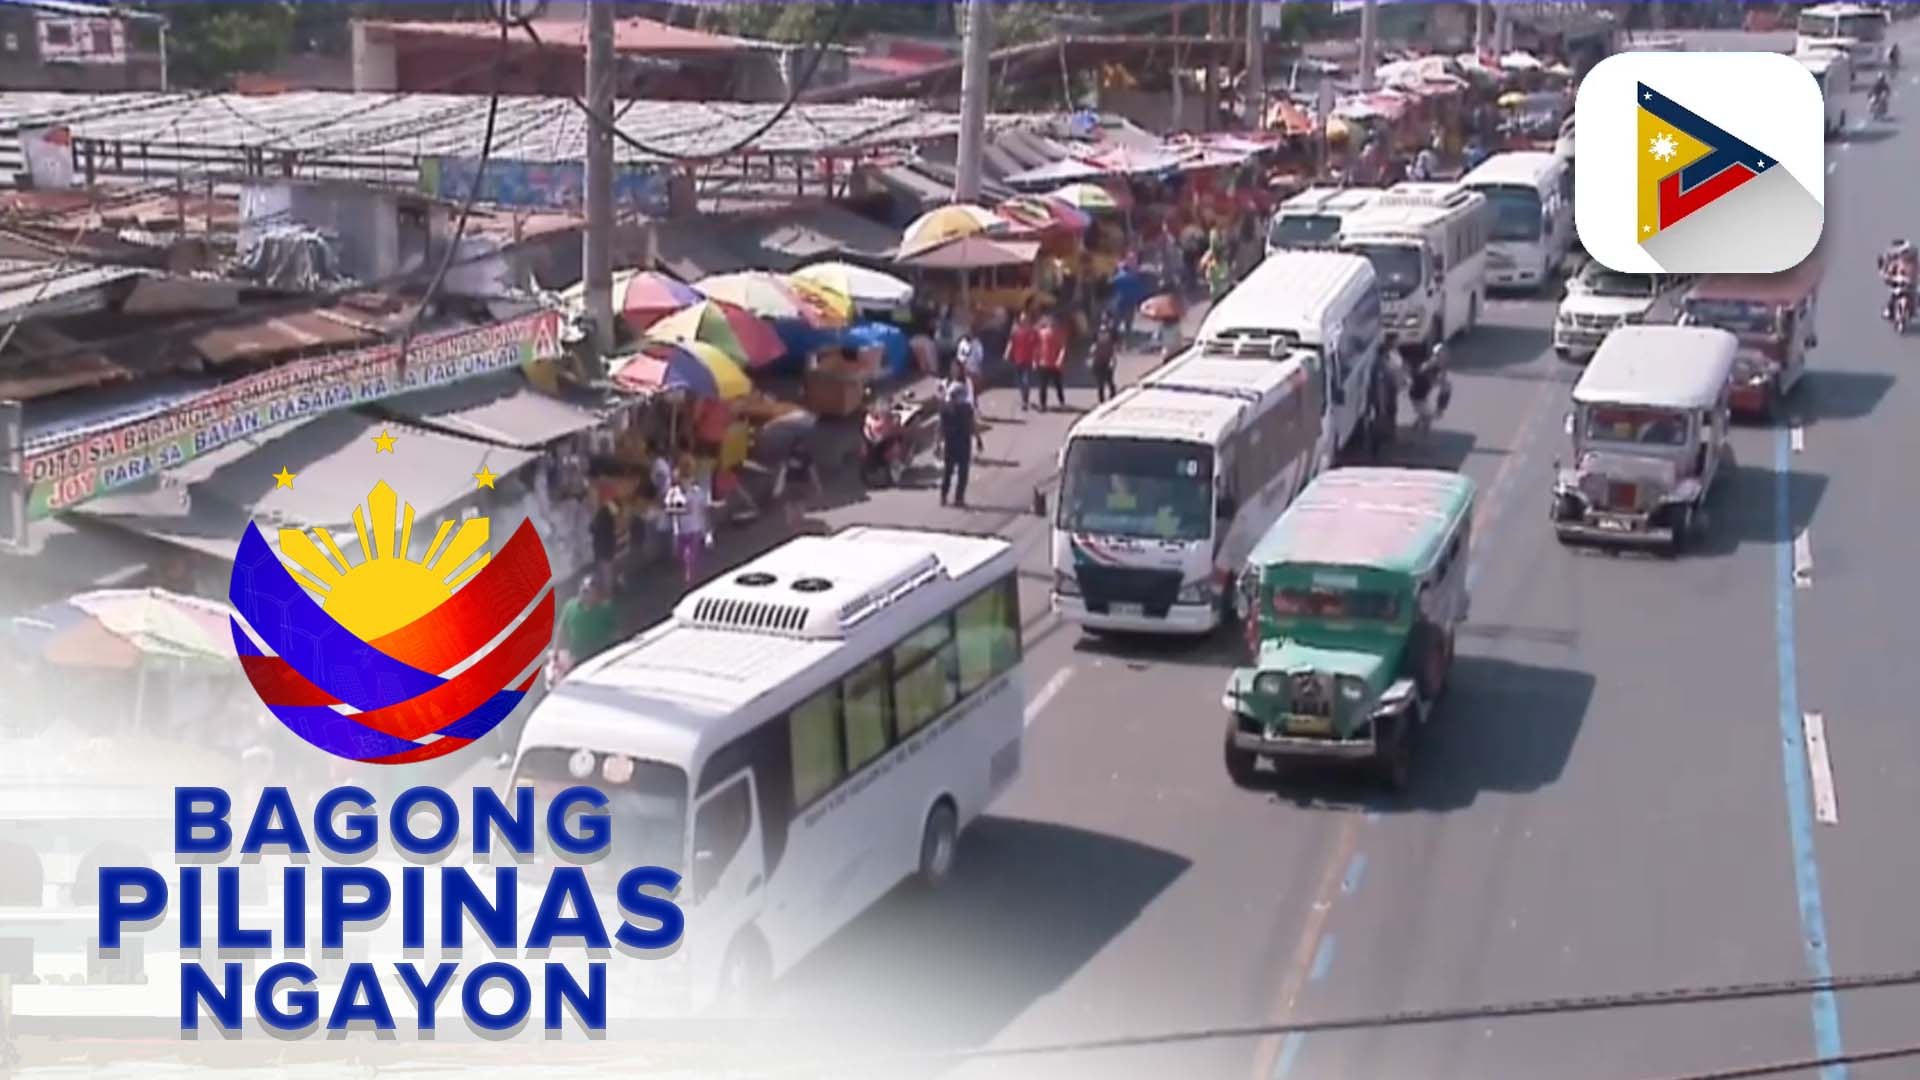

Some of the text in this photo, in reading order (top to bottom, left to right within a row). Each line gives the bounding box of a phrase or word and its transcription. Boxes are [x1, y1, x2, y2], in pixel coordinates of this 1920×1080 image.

[30, 447, 82, 482] DITO
[90, 438, 115, 463] SA
[50, 470, 97, 506] JOY
[103, 456, 153, 488] PARA
[160, 443, 183, 467] SA
[270, 386, 353, 421] KASAMA
[360, 377, 388, 398] KA
